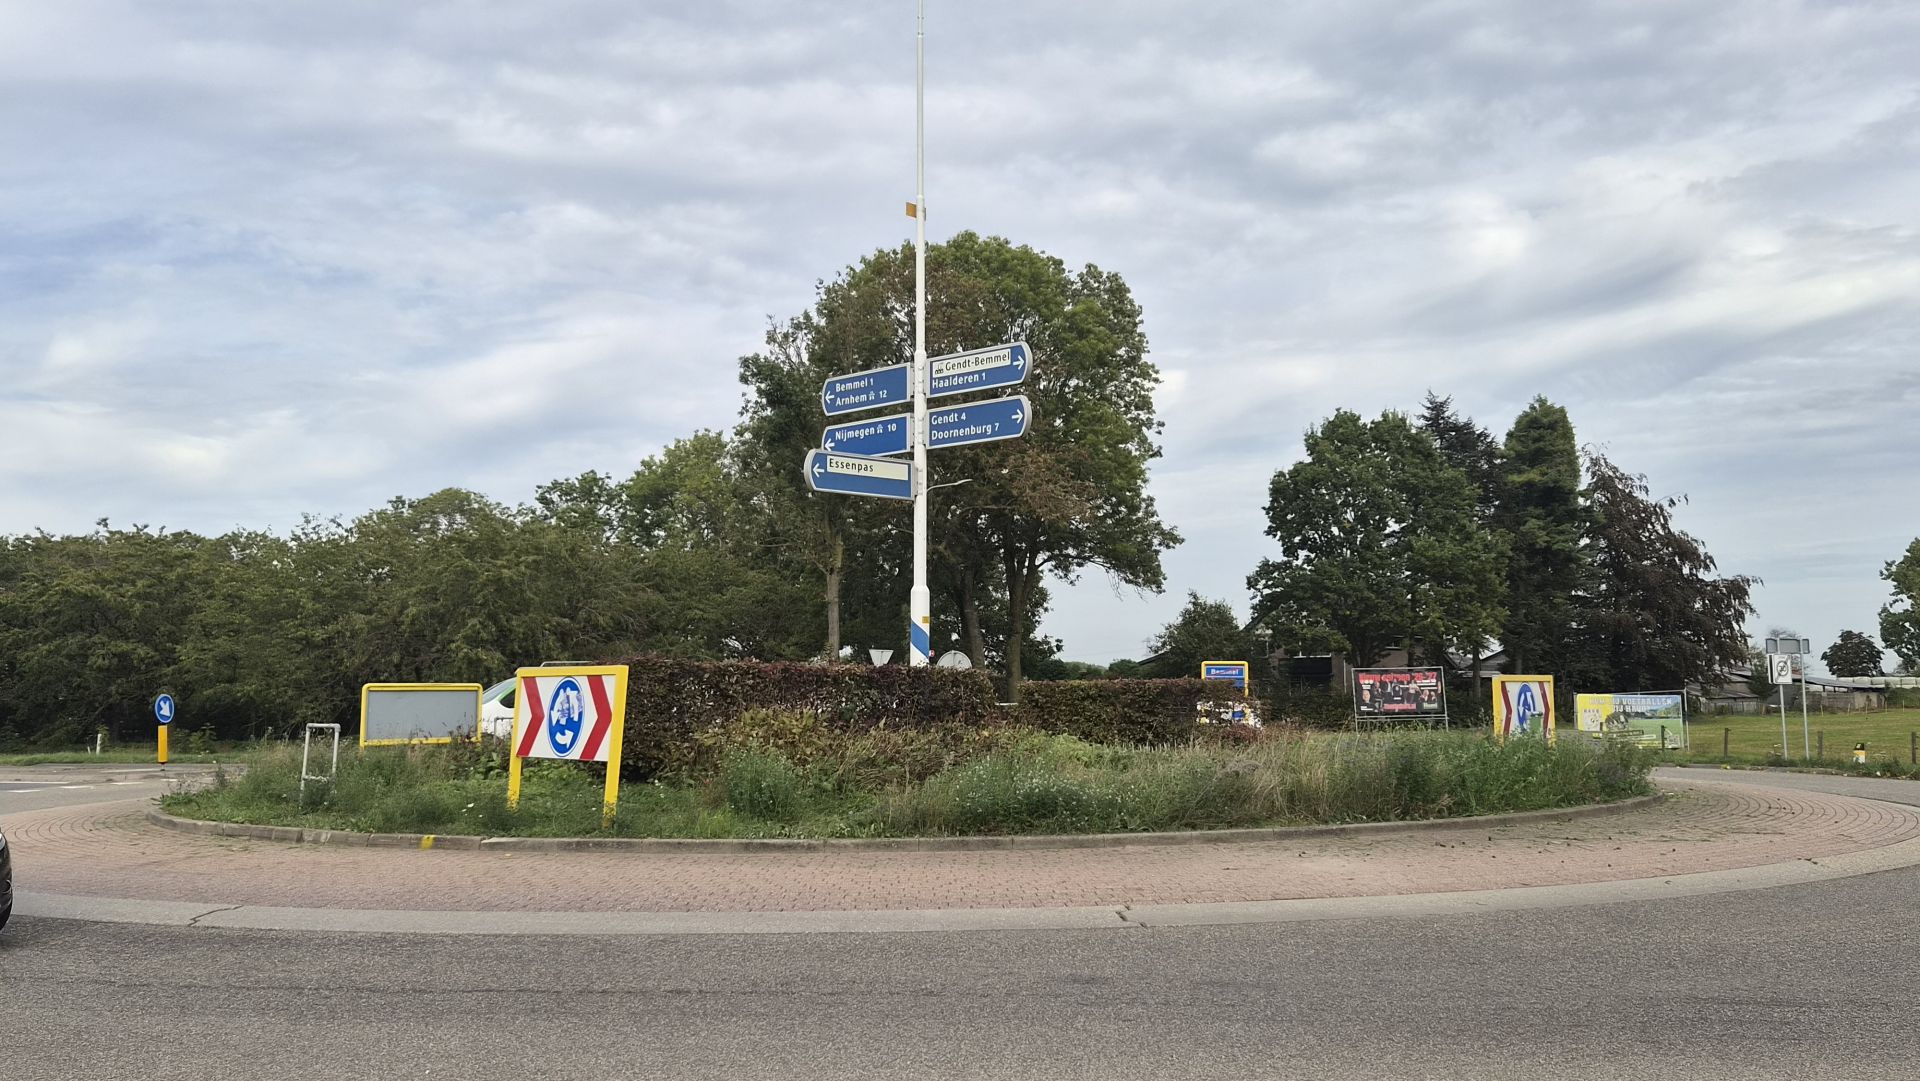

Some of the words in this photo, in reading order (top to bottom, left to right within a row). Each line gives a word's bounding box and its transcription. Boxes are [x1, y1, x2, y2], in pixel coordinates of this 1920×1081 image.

[945, 351, 1010, 371] Gendt-Bemmel
[836, 378, 868, 392] Bemmel
[870, 378, 874, 386] 1
[932, 373, 979, 389] Haalderen
[982, 372, 986, 381] 1
[836, 394, 867, 407] Arnhem
[879, 390, 888, 398] 12
[931, 412, 959, 425] Gendt
[961, 412, 966, 420] 4
[835, 427, 875, 441] Nijmegen
[888, 423, 897, 432] 10
[931, 423, 992, 440] Doornenburg
[995, 423, 1000, 432] 7
[829, 458, 874, 473] Essenpas
